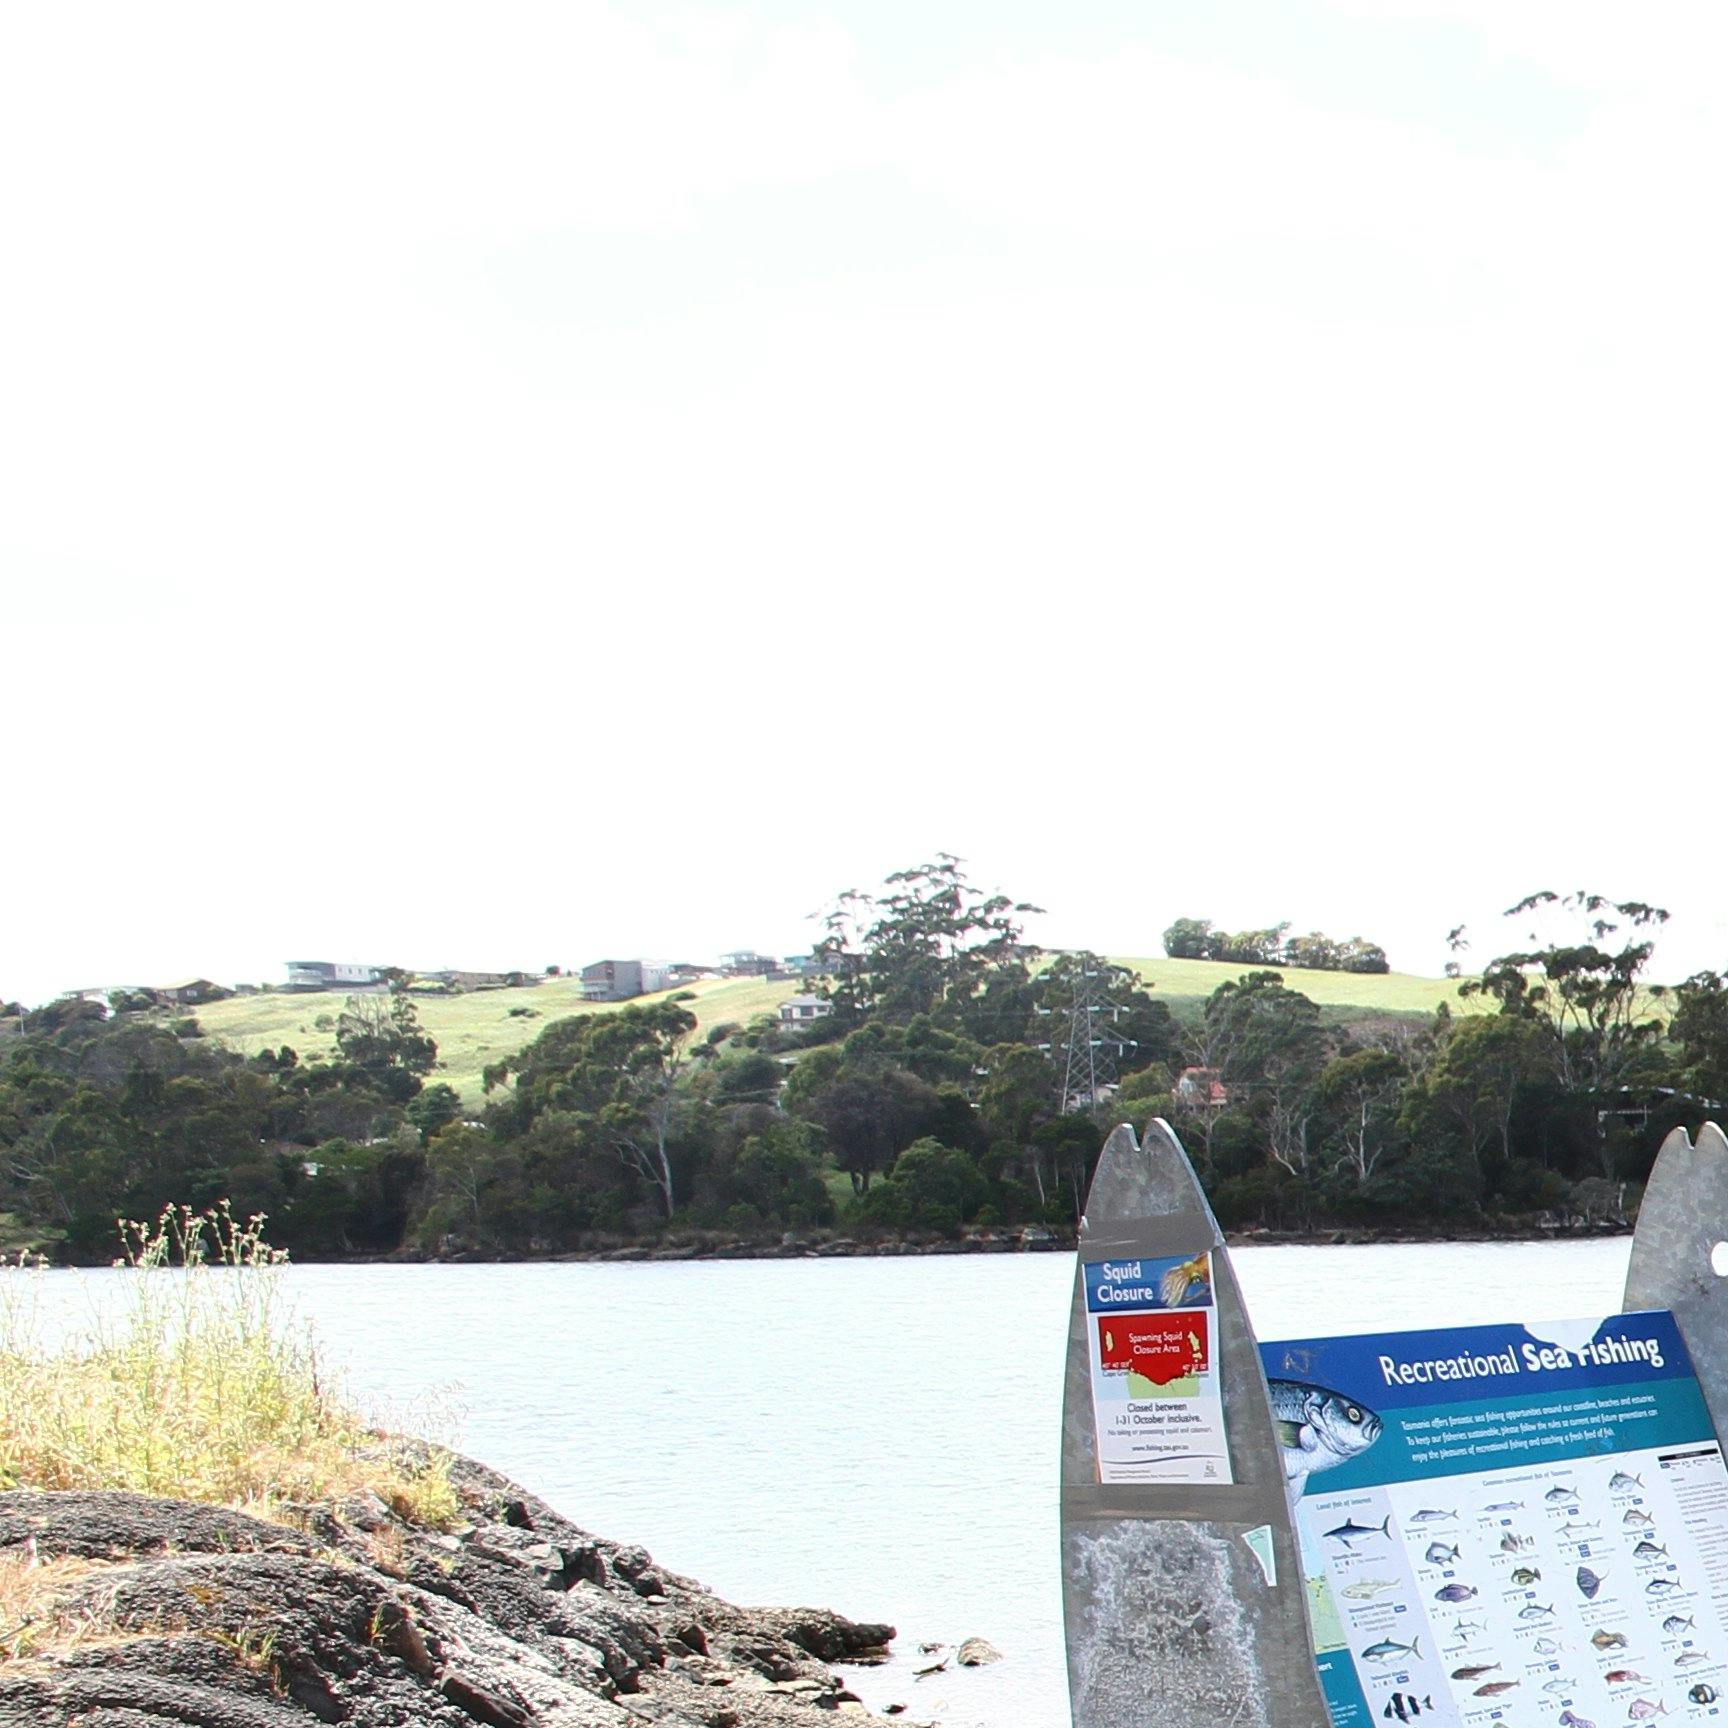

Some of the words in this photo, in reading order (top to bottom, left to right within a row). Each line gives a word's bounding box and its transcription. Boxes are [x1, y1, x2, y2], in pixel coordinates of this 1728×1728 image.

[1103, 1261, 1141, 1284] Squid
[1097, 1285, 1153, 1302] Closure
[1128, 1332, 1162, 1344] Spawning
[1163, 1331, 1183, 1342] Squid
[1133, 1345, 1162, 1354] Closure
[1163, 1344, 1180, 1353] Area
[1379, 1344, 1520, 1386] Recreational
[1522, 1342, 1572, 1372] Sea
[1127, 1403, 1153, 1413] Closed
[1155, 1403, 1187, 1411] between
[1115, 1415, 1130, 1425] 1-31
[1133, 1415, 1165, 1424] October
[1167, 1414, 1202, 1423] inclusive.
